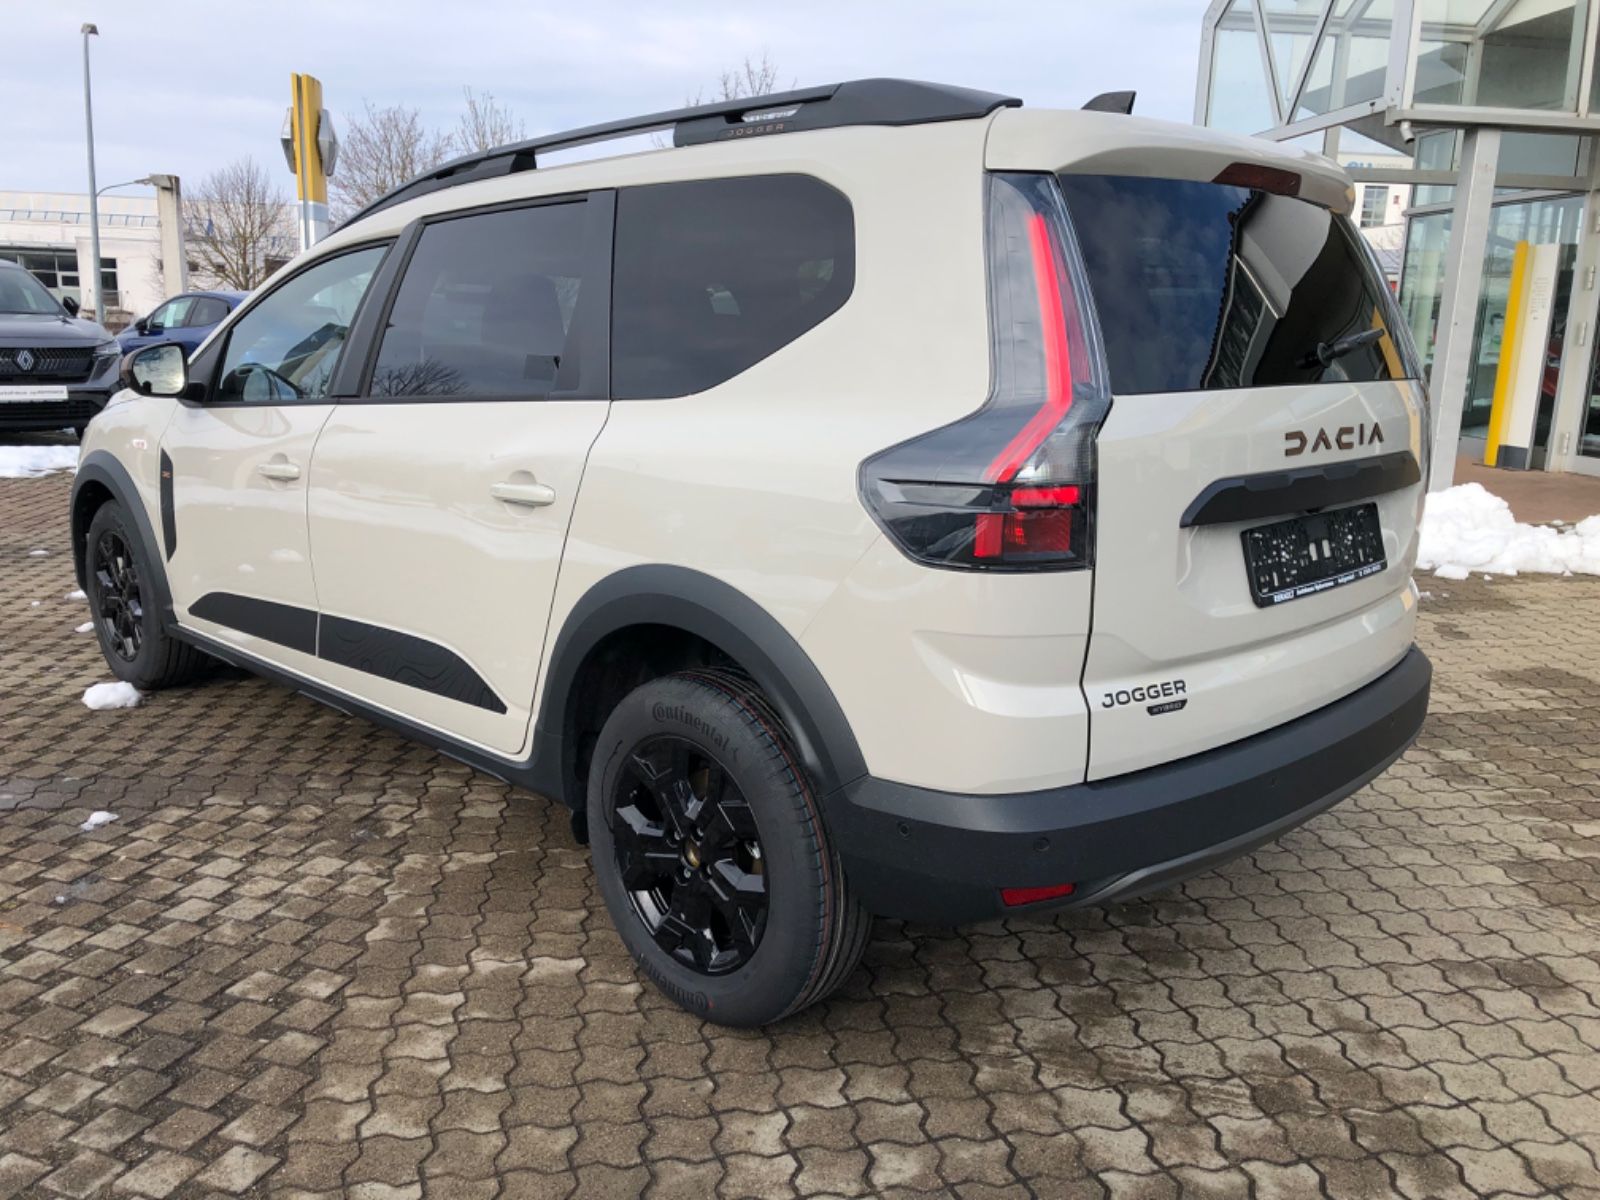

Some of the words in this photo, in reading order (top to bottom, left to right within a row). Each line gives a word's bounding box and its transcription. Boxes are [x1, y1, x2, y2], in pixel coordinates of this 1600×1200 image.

[727, 123, 784, 136] JOGGER
[1284, 422, 1384, 457] DACIA
[1102, 679, 1187, 708] JOGGER
[652, 701, 730, 752] Continental
